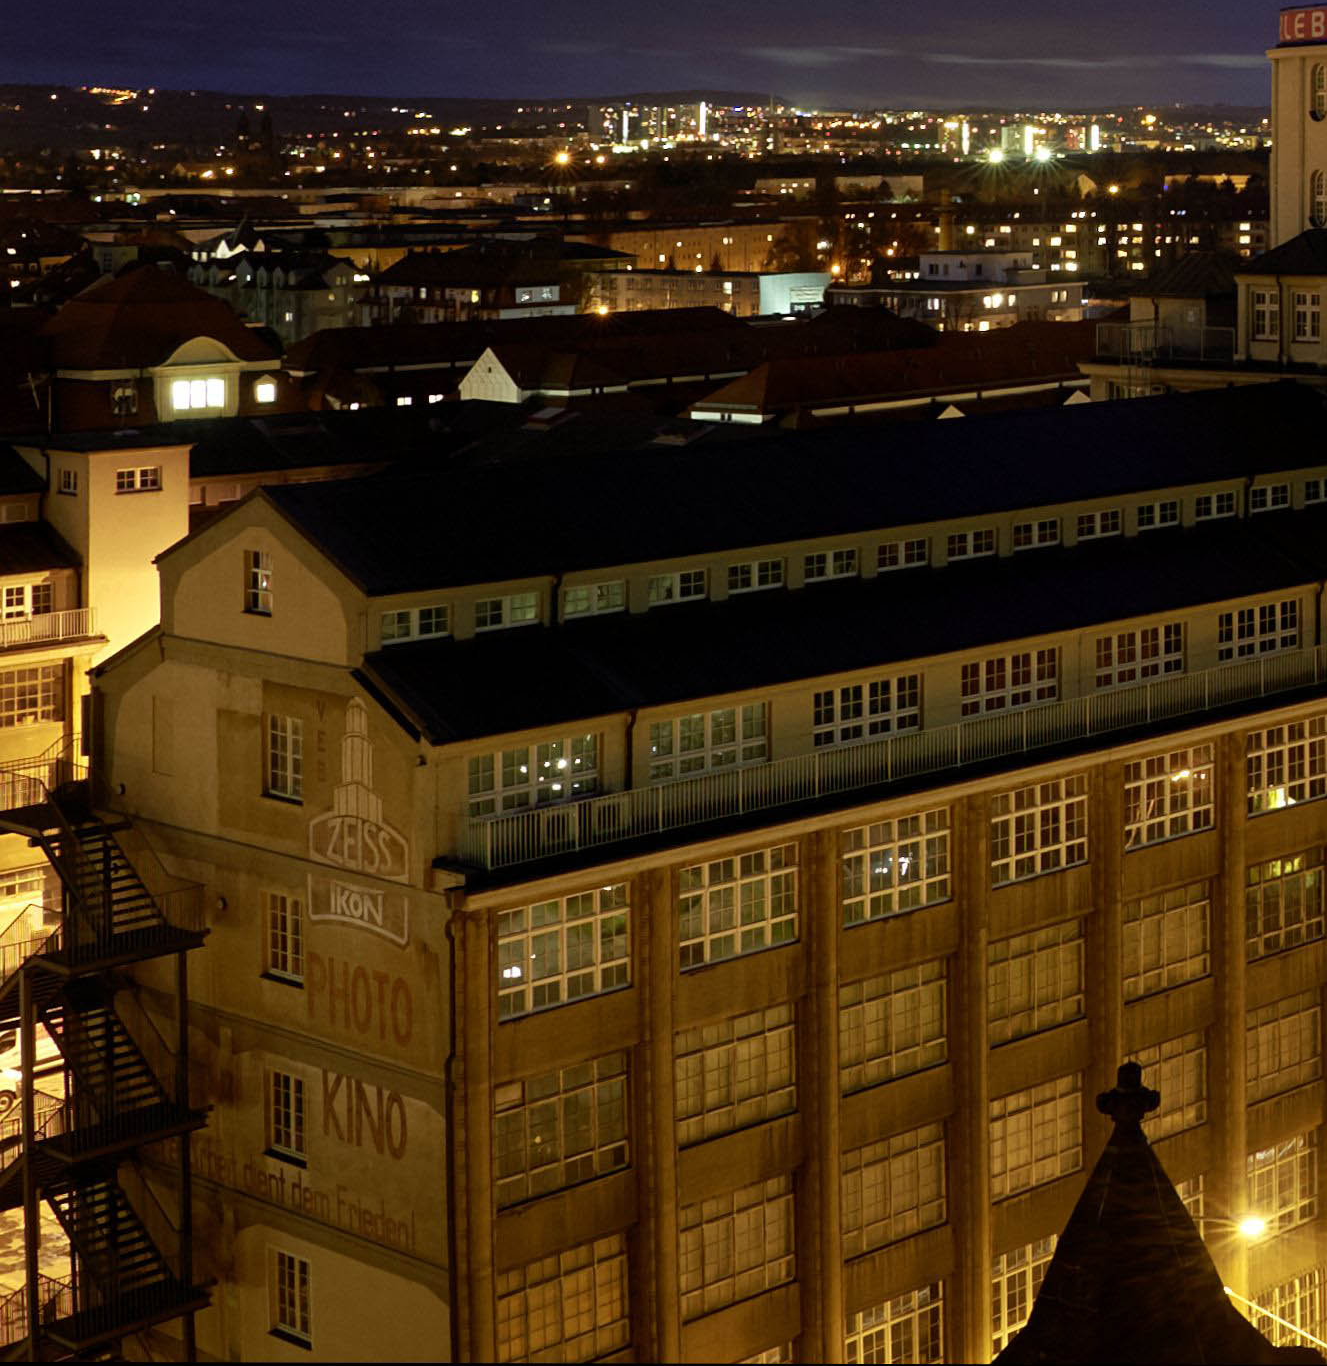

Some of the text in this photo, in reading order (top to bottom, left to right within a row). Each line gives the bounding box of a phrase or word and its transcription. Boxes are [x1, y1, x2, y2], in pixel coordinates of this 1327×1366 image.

[327, 819, 392, 874] ZEISS
[330, 887, 384, 926] IKON
[307, 952, 412, 1047] PHOTO
[322, 1067, 407, 1161] KINO
